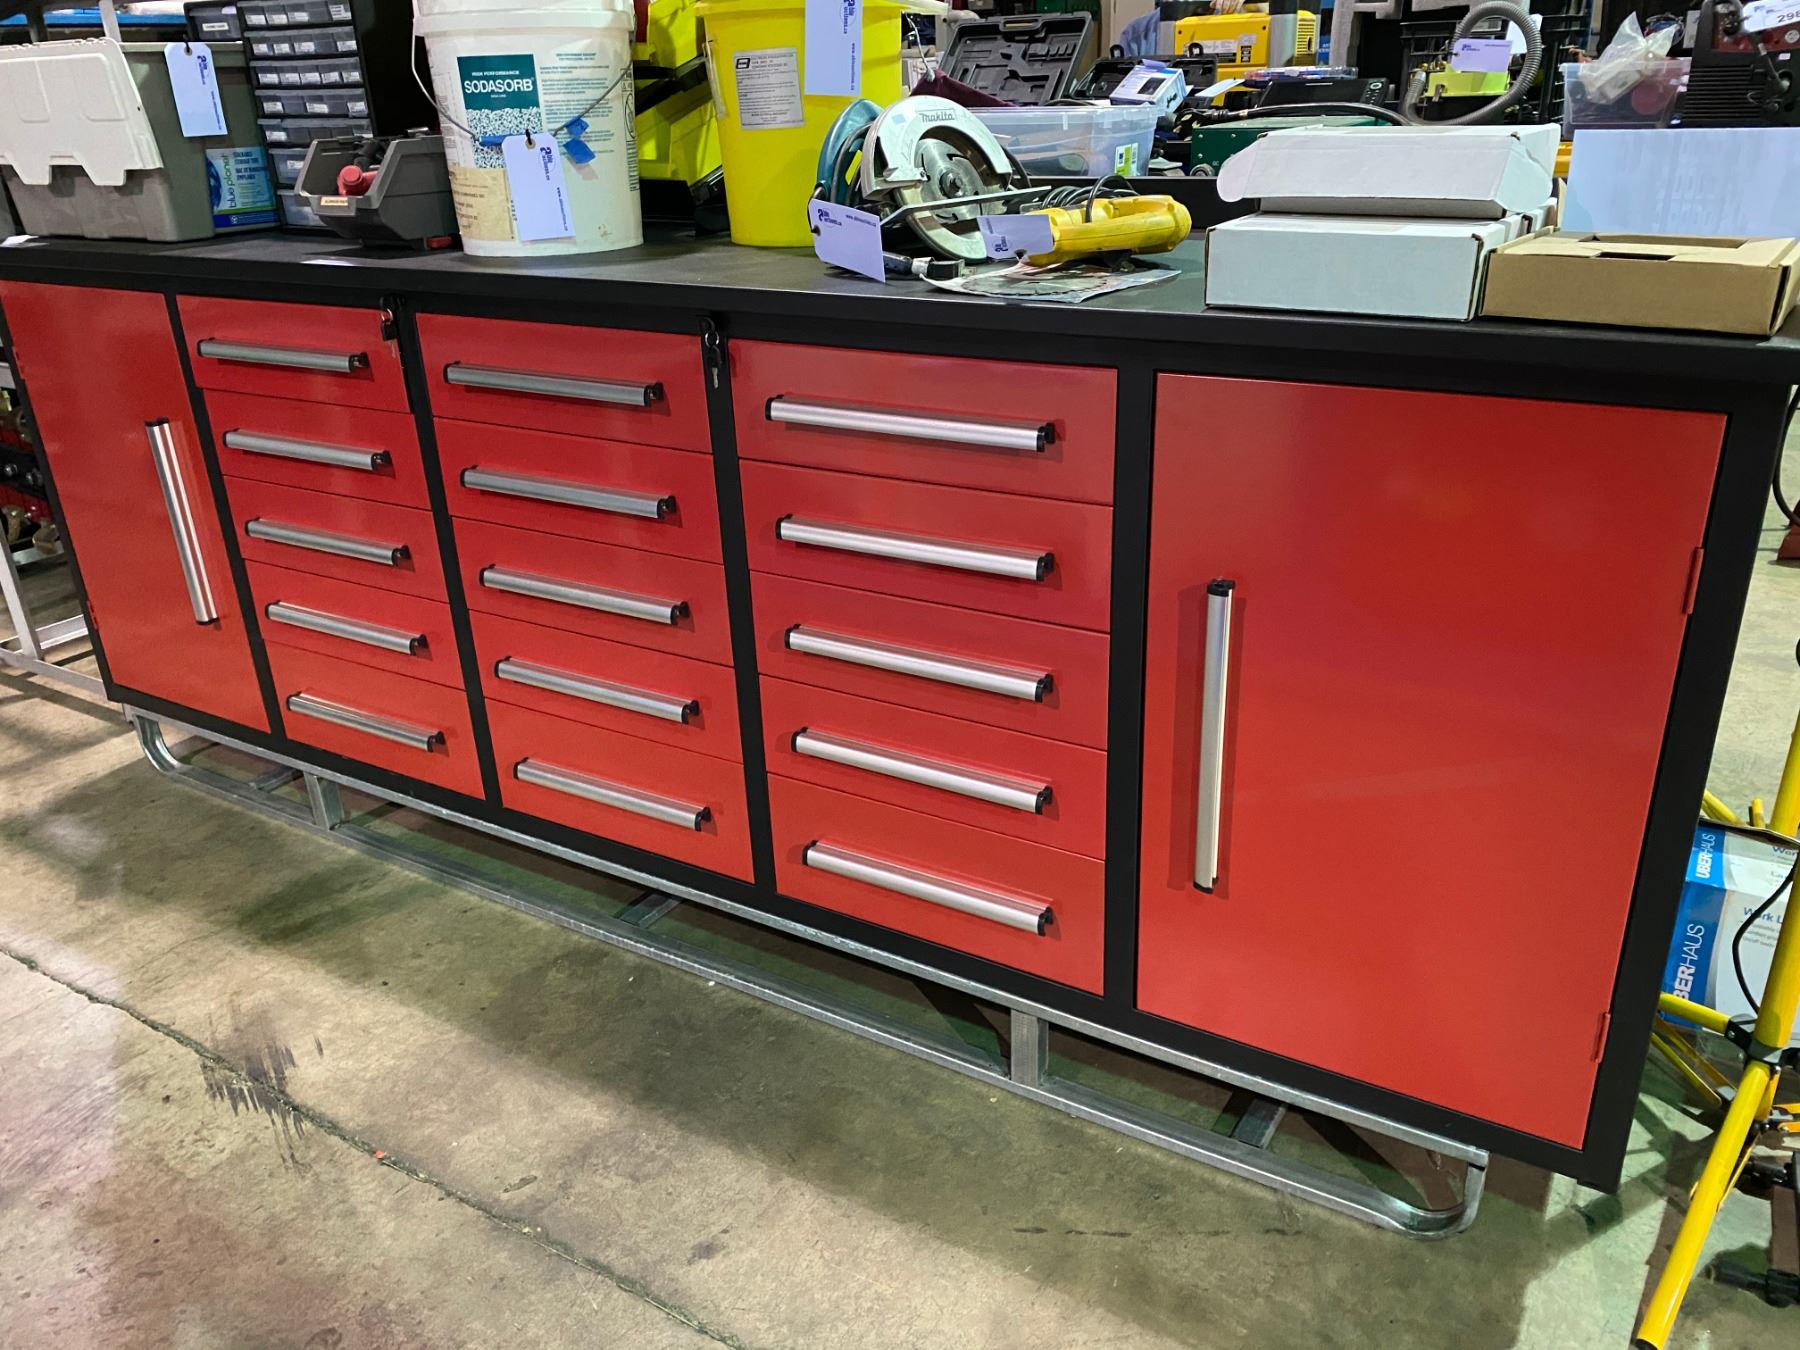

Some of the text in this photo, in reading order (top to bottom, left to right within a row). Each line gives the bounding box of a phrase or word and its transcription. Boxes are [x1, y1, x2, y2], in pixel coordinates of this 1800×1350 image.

[464, 79, 533, 93] SODASORB
[221, 154, 237, 208] blue planet
[1696, 833, 1716, 879] UBERHAUS
[1772, 846, 1796, 856] Wor
[1744, 907, 1774, 922] Wrk
[1673, 924, 1705, 1001] BERHAUS
